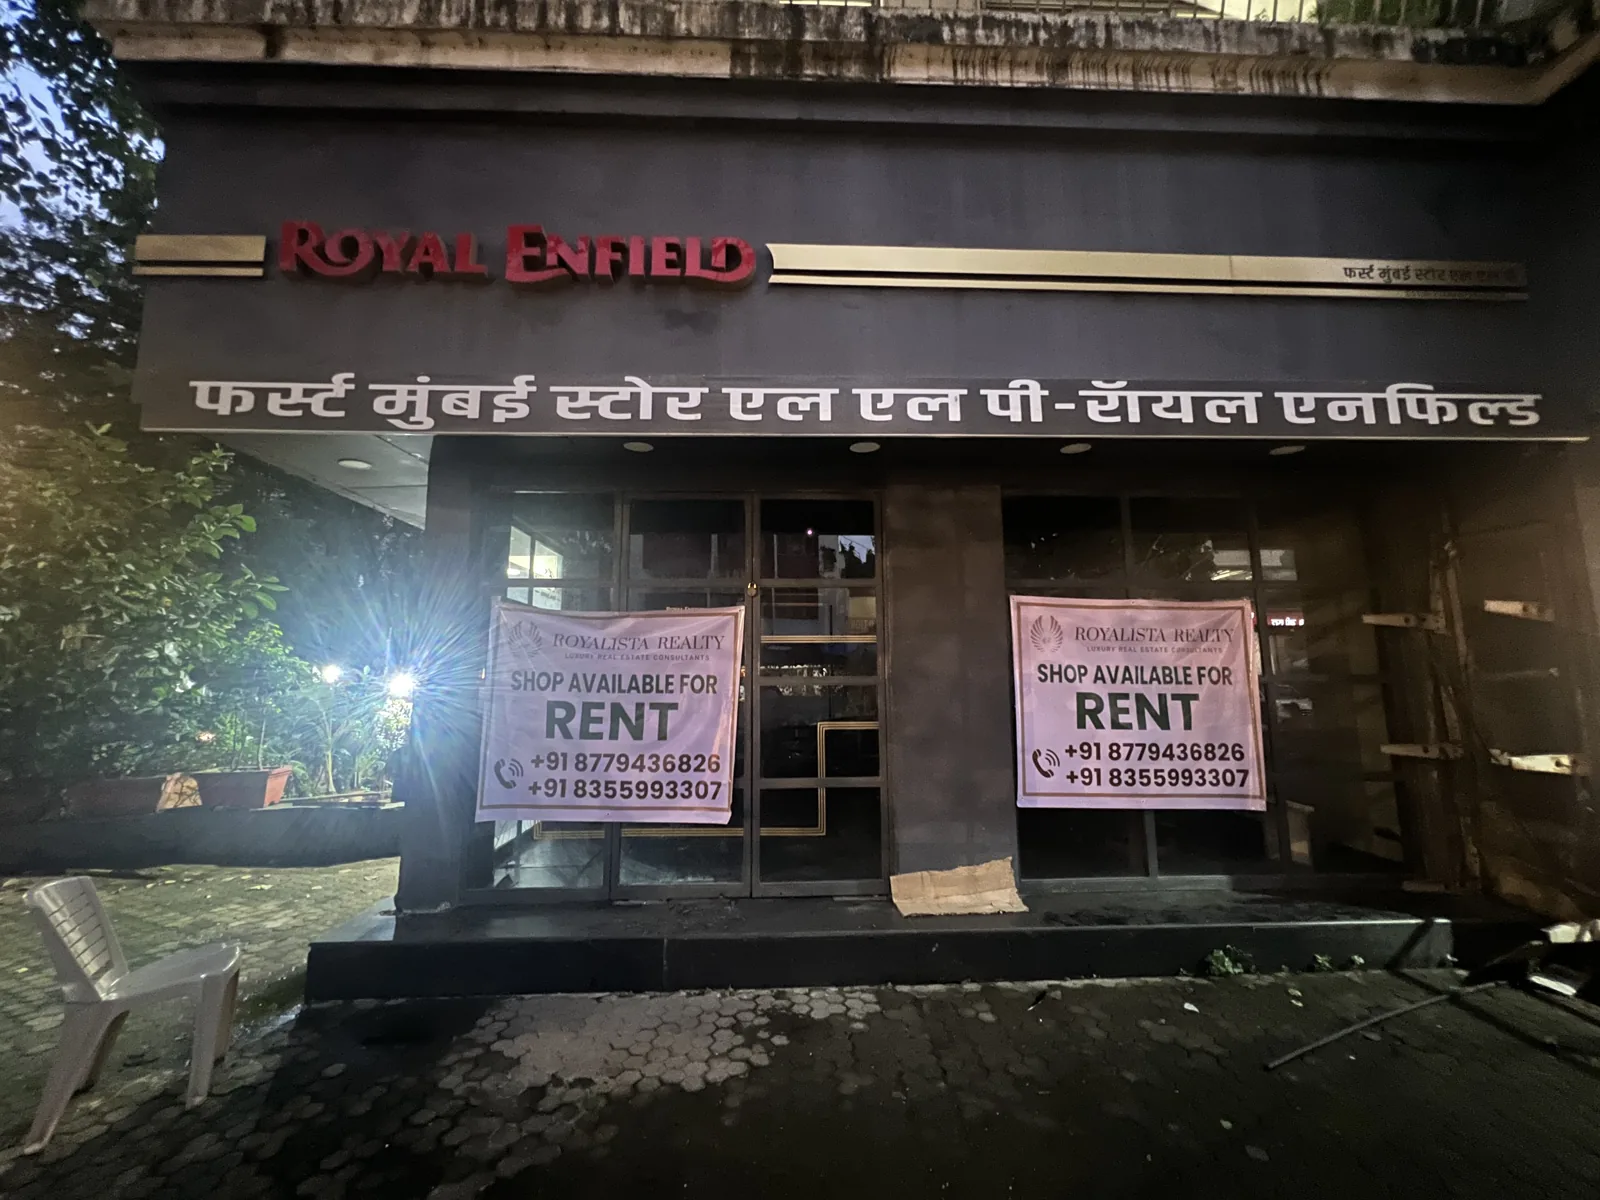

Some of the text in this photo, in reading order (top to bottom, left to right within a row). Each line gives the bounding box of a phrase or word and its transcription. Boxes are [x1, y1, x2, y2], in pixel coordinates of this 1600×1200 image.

[279, 221, 757, 284] ROYAL ENFIELD
[189, 372, 355, 417] फर्स्ट
[368, 375, 537, 430] मुंबई
[550, 376, 709, 420] स्टोर
[721, 387, 840, 421] एल
[852, 388, 968, 422] एल
[1274, 383, 1542, 426] एनफिल्ड
[553, 633, 725, 651] ROYALISTA REALTY
[1075, 626, 1234, 643] ROYALISTA REALTY
[511, 670, 718, 694] SHOP AVAILABLE FOR
[1037, 664, 1232, 685] SHOP AVAILABLE FOR
[545, 700, 679, 741] RENT
[1075, 692, 1200, 731] RENT
[1065, 742, 1245, 761] +91 8779436826
[531, 752, 721, 773] +91 8779436826
[1066, 768, 1249, 787] +91 8355993307
[528, 778, 722, 800] +91 8355993307
